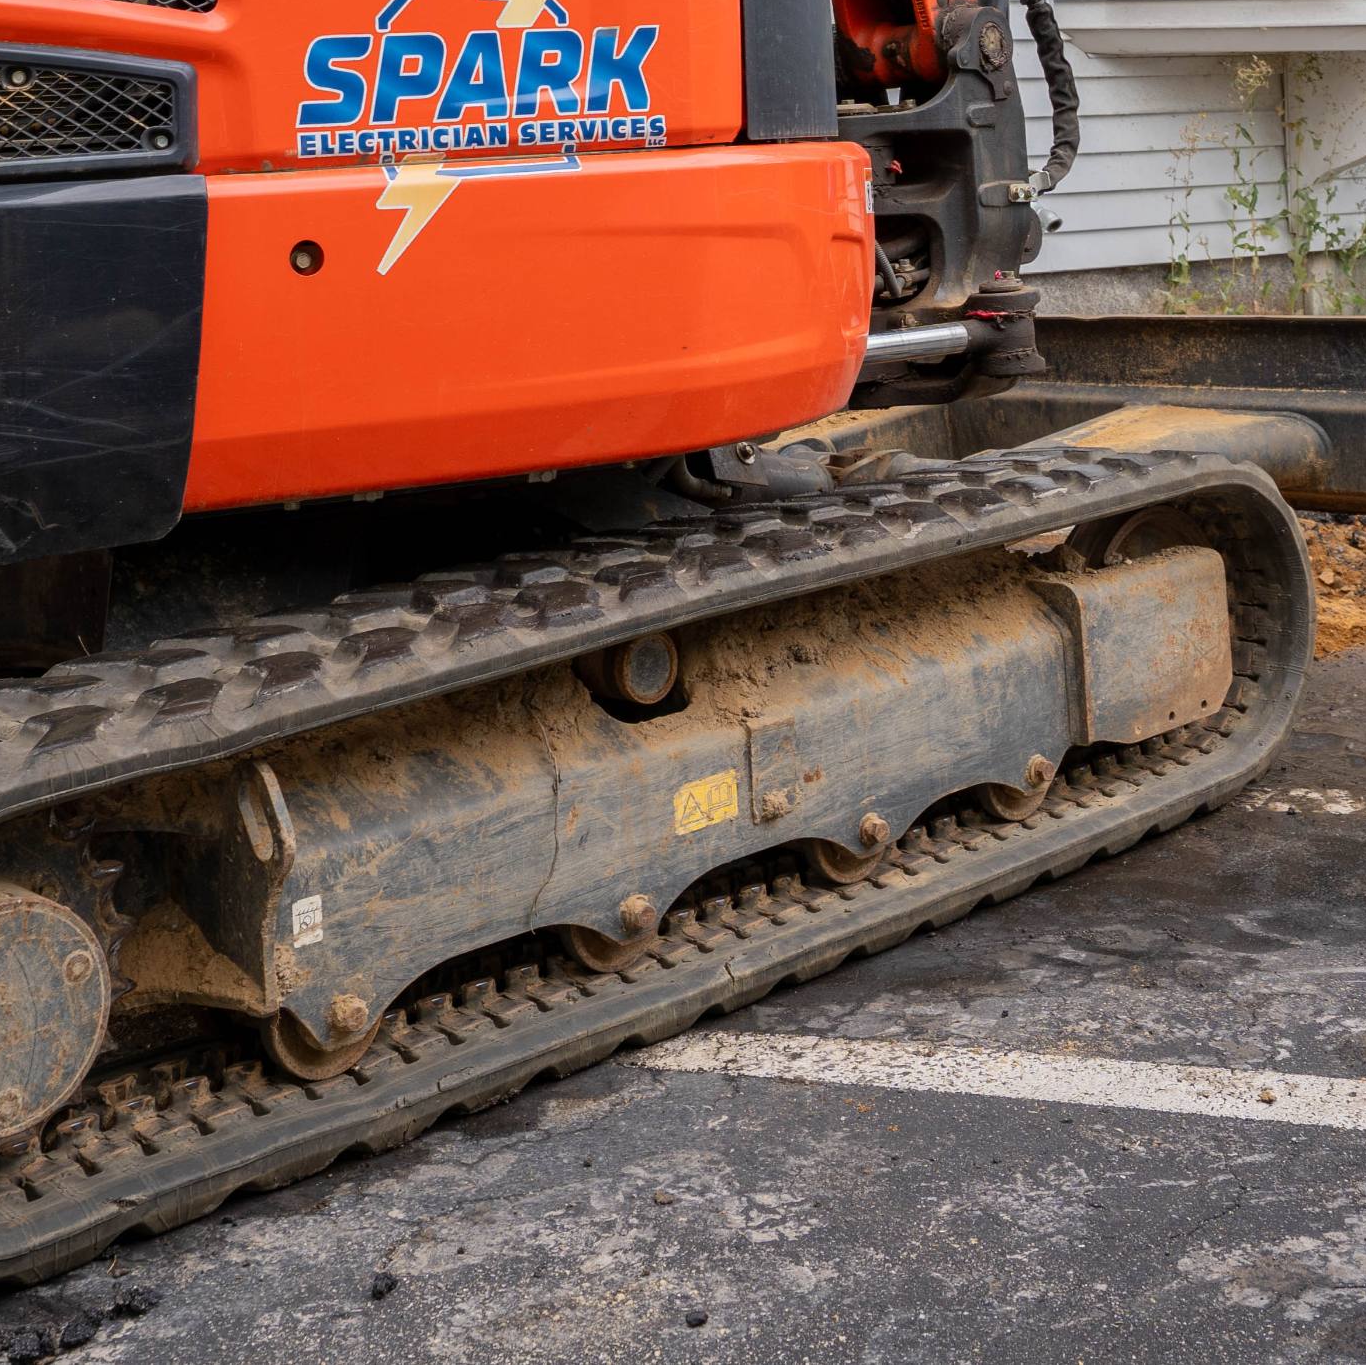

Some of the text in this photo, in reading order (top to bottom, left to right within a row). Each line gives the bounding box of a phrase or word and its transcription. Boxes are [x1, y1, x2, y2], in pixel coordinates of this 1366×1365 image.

[297, 26, 658, 127] SPARK
[298, 115, 665, 156] ELECTRICIAN SERVICES LLC
